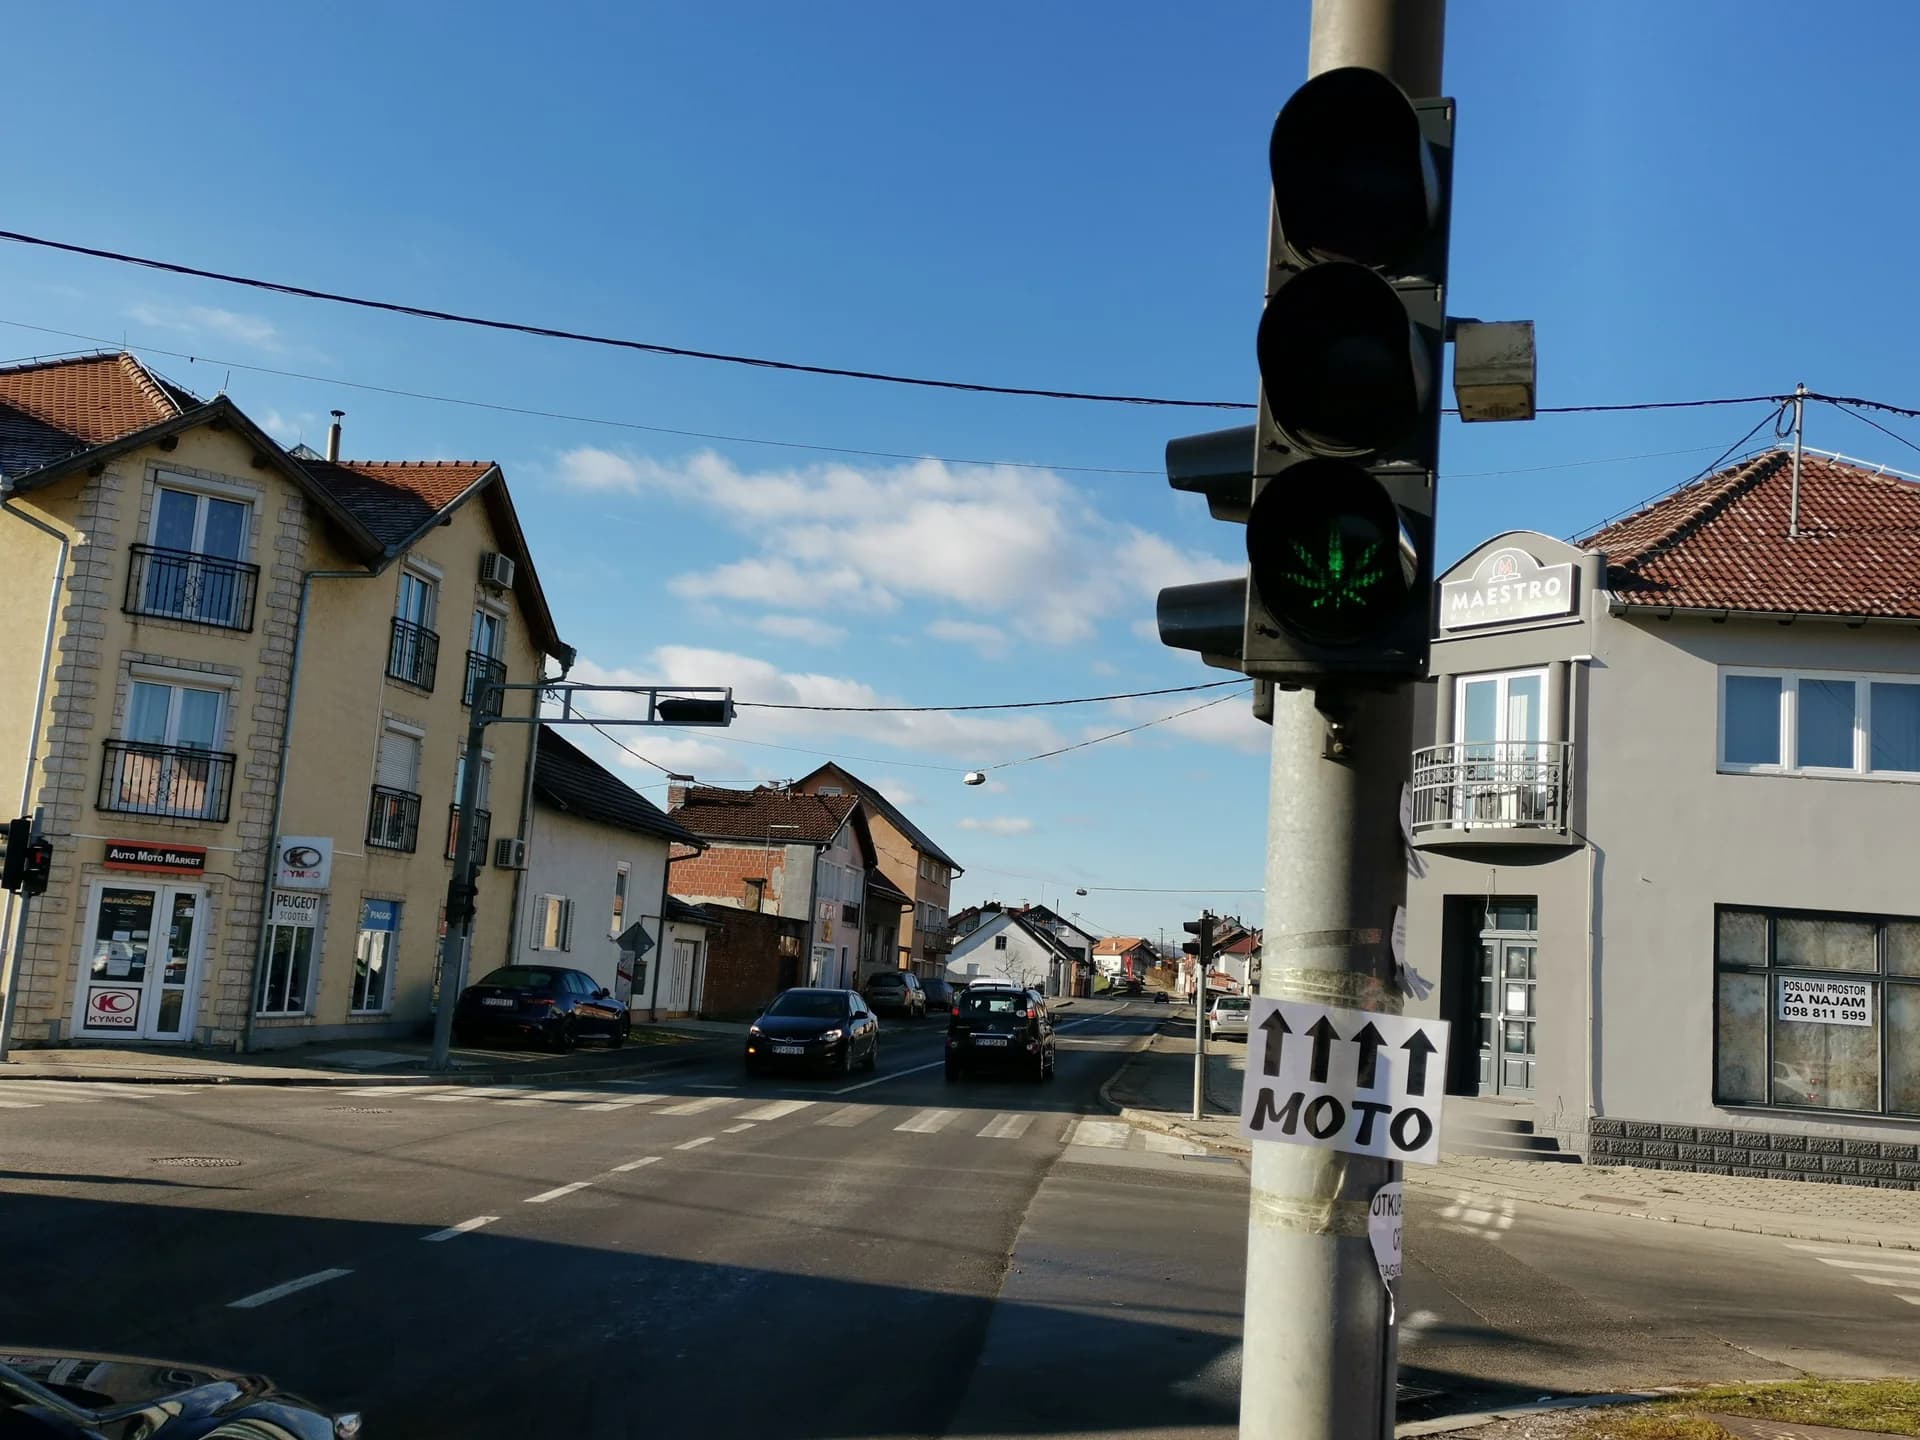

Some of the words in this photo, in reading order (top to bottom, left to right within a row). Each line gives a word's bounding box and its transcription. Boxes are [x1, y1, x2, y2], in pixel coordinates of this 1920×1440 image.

[1451, 577, 1561, 610] MAESTRO
[110, 848, 136, 860] AUTO
[137, 851, 164, 863] MOTO
[165, 853, 201, 865] MARKET
[282, 869, 321, 879] KYMCO
[276, 894, 318, 910] PEUGEOT
[279, 910, 312, 922] SCOOTERS
[1783, 980, 1825, 993] POSLOVNI
[1827, 984, 1866, 996] PROSTOR
[1784, 993, 1804, 1004] ZA
[1809, 995, 1866, 1008] NAJAM
[88, 1015, 133, 1024] KYMCO
[1783, 1006, 1808, 1017] 098
[1812, 1008, 1836, 1019] 811
[1842, 1010, 1866, 1021] 599
[1249, 1087, 1432, 1152] MOTO
